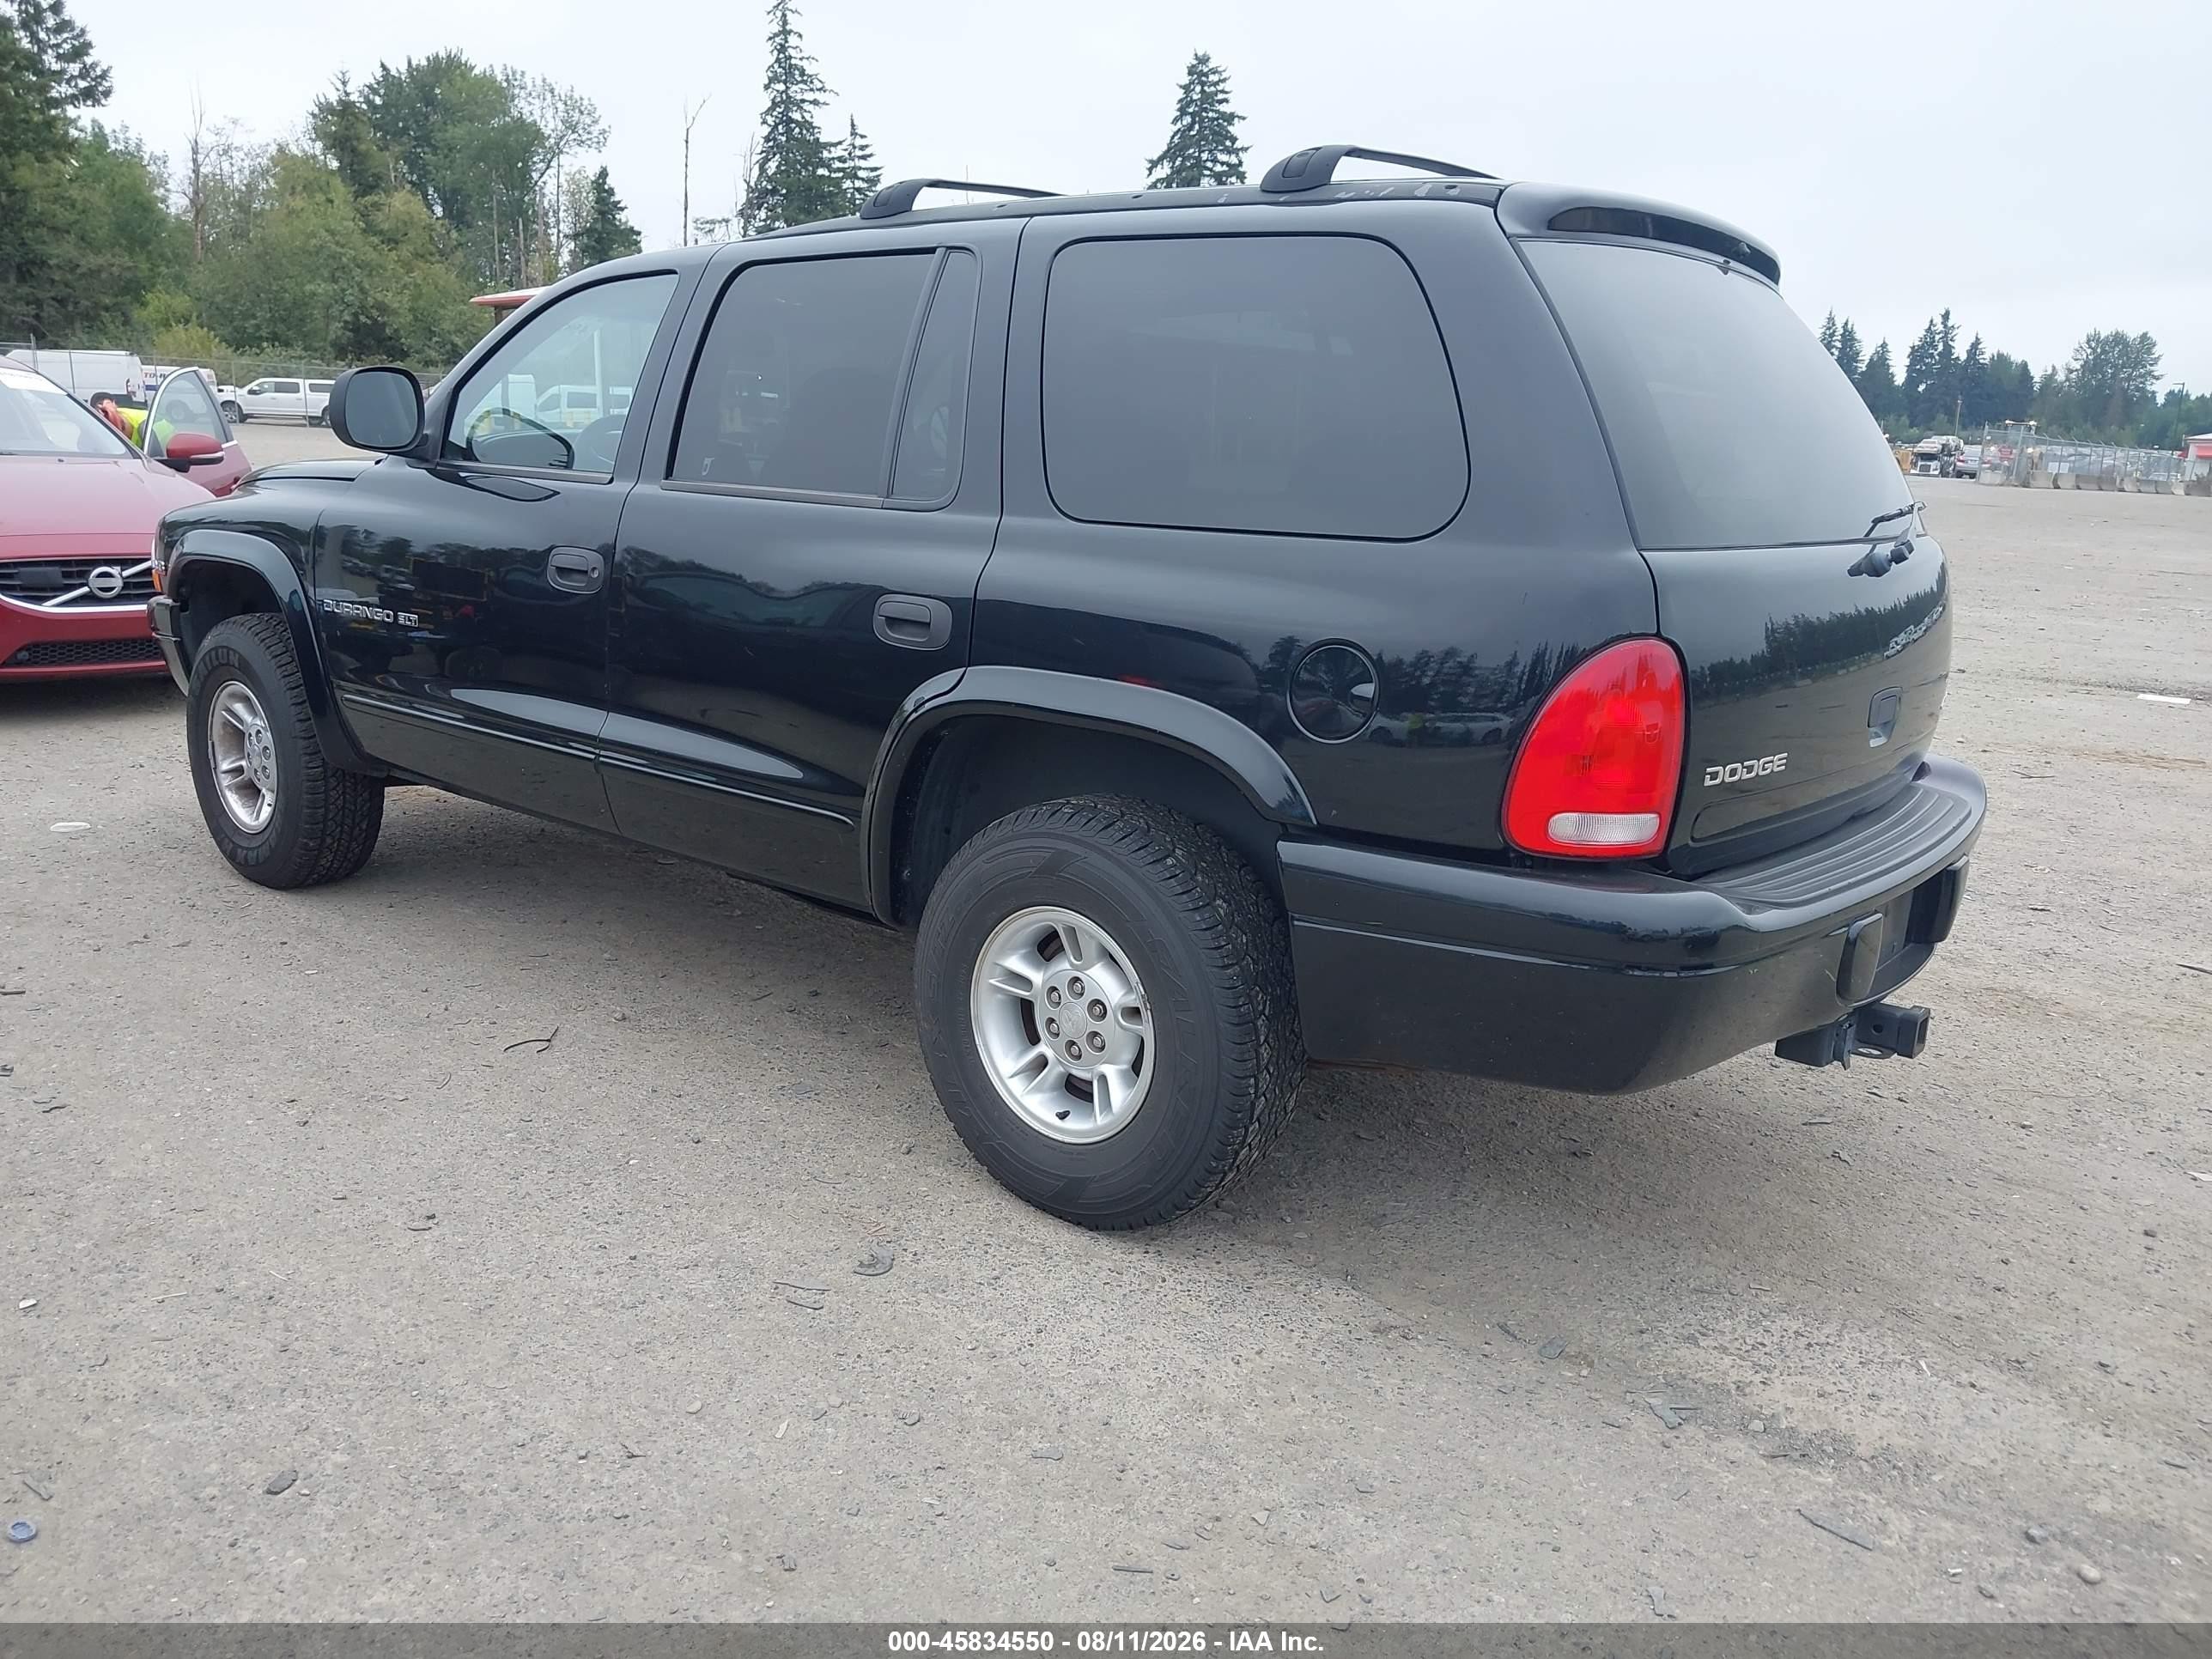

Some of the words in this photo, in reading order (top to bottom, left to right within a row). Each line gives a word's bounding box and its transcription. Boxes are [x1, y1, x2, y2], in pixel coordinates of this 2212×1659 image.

[323, 599, 393, 623] DURANGO
[397, 612, 418, 628] SLT
[1704, 752, 1788, 787] DODGE
